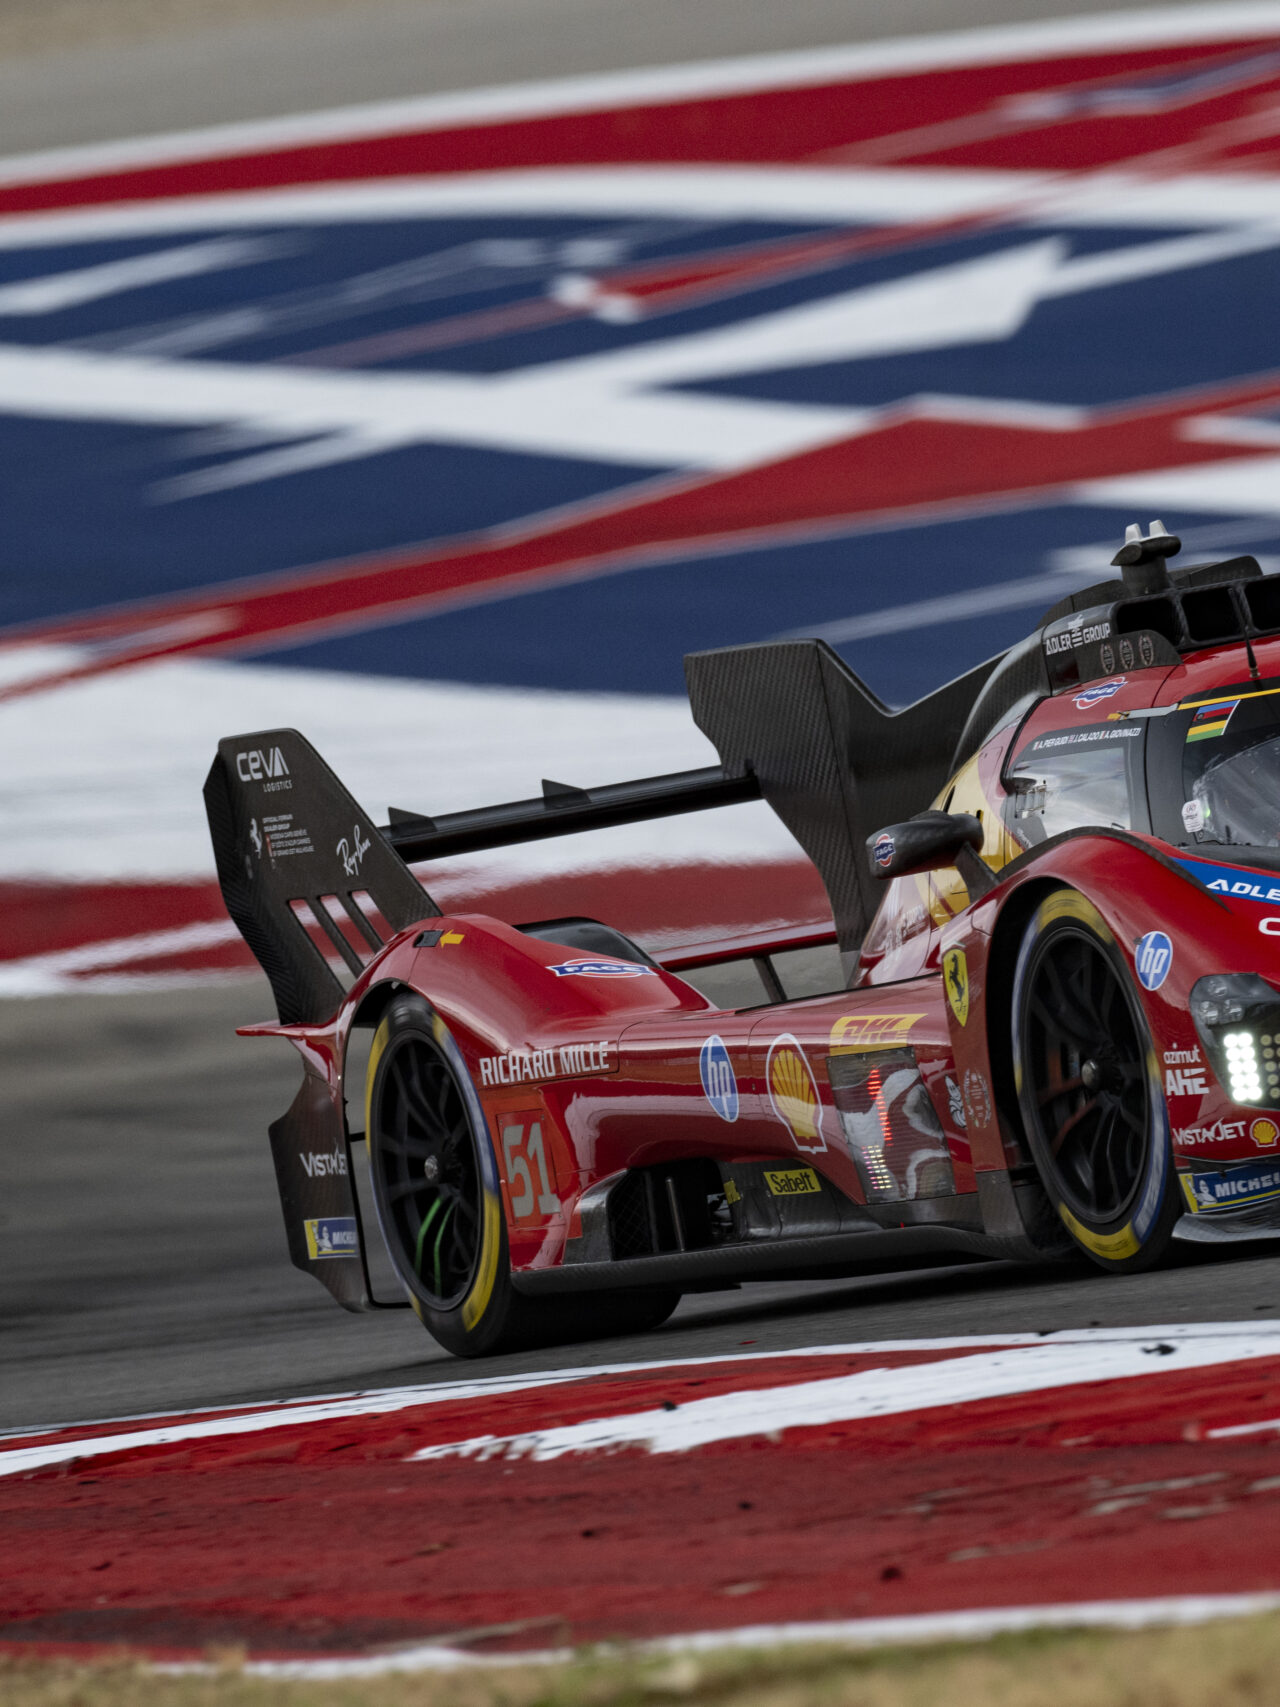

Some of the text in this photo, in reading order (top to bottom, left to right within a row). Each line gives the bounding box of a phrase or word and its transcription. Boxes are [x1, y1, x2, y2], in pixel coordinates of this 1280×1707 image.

[1045, 622, 1111, 655] ADLER GROUP
[262, 780, 293, 793] LOGISTICS
[479, 1041, 610, 1086] RICHARD MILLE
[1163, 1042, 1202, 1064] azimut
[1166, 1067, 1210, 1096] AHE
[503, 1122, 562, 1218] 51
[773, 1171, 815, 1193] Sabelt
